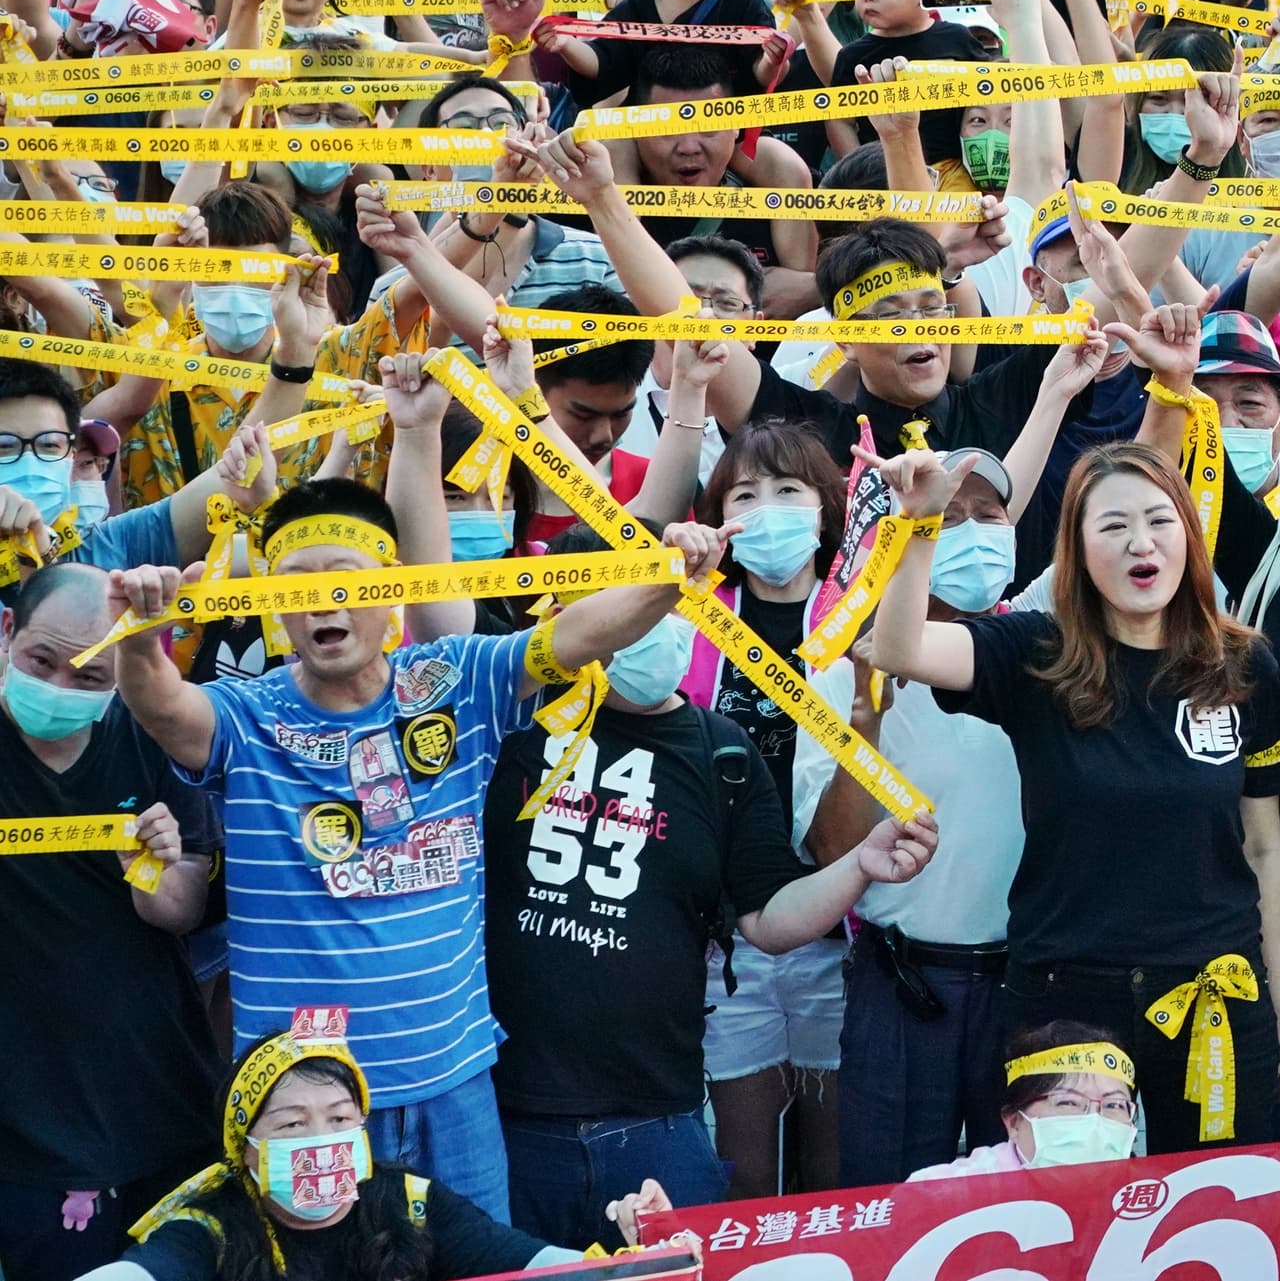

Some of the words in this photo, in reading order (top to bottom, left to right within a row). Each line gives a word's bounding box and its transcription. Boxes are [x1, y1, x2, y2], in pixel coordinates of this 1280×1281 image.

[594, 108, 624, 125] We
[626, 105, 670, 122] Care
[702, 100, 746, 118] 0606
[748, 94, 806, 114] 光復高雄
[837, 88, 880, 108] 2020
[882, 80, 971, 106] 高雄人寫歷史
[1000, 74, 1046, 94] 0606
[1047, 69, 1105, 90] 天佑台灣
[1112, 64, 1143, 82] We
[1146, 60, 1185, 80] Vote
[17, 136, 58, 152] 0606
[60, 136, 118, 154] 光復高雄
[148, 137, 190, 154] 2020
[192, 136, 280, 154] 高雄人寫歷史
[310, 136, 354, 153] 0606
[356, 136, 414, 153] 天佑台灣
[421, 135, 453, 151] We
[456, 135, 493, 151] Vote
[625, 190, 666, 207] 2020
[666, 189, 757, 210] 高雄人寫歷史
[784, 193, 826, 210] 0606
[824, 192, 886, 212] 天佑台灣
[888, 193, 922, 213] Yes
[1124, 202, 1168, 219] 0606
[1171, 207, 1231, 226] 光復高雄
[0, 249, 91, 270] 高雄人寫歷史
[123, 255, 170, 273] 0606
[172, 256, 232, 275] 天佑台灣
[856, 270, 894, 298] 2020
[533, 440, 570, 480] 0606
[566, 474, 622, 524] 光復高雄
[282, 519, 373, 548] 高雄人寫歷史
[203, 594, 253, 613] 0606
[255, 587, 321, 611] 光復高雄
[356, 583, 405, 602] 2020
[407, 572, 507, 599] 高雄人寫歷史
[542, 568, 592, 587] 0606
[593, 561, 660, 585] 天佑台灣
[763, 662, 806, 705] 0606
[800, 698, 855, 749] 天佑台灣
[851, 743, 882, 777] We
[875, 768, 916, 810] Vote
[47, 822, 114, 844] 天佑台灣
[602, 799, 669, 840] PEACE
[527, 803, 648, 900] 53
[528, 887, 568, 904] LOVE
[590, 901, 627, 919] LIFE
[518, 908, 544, 936] 911
[1206, 1035, 1224, 1079] Care
[707, 1196, 896, 1252] 台灣基進
